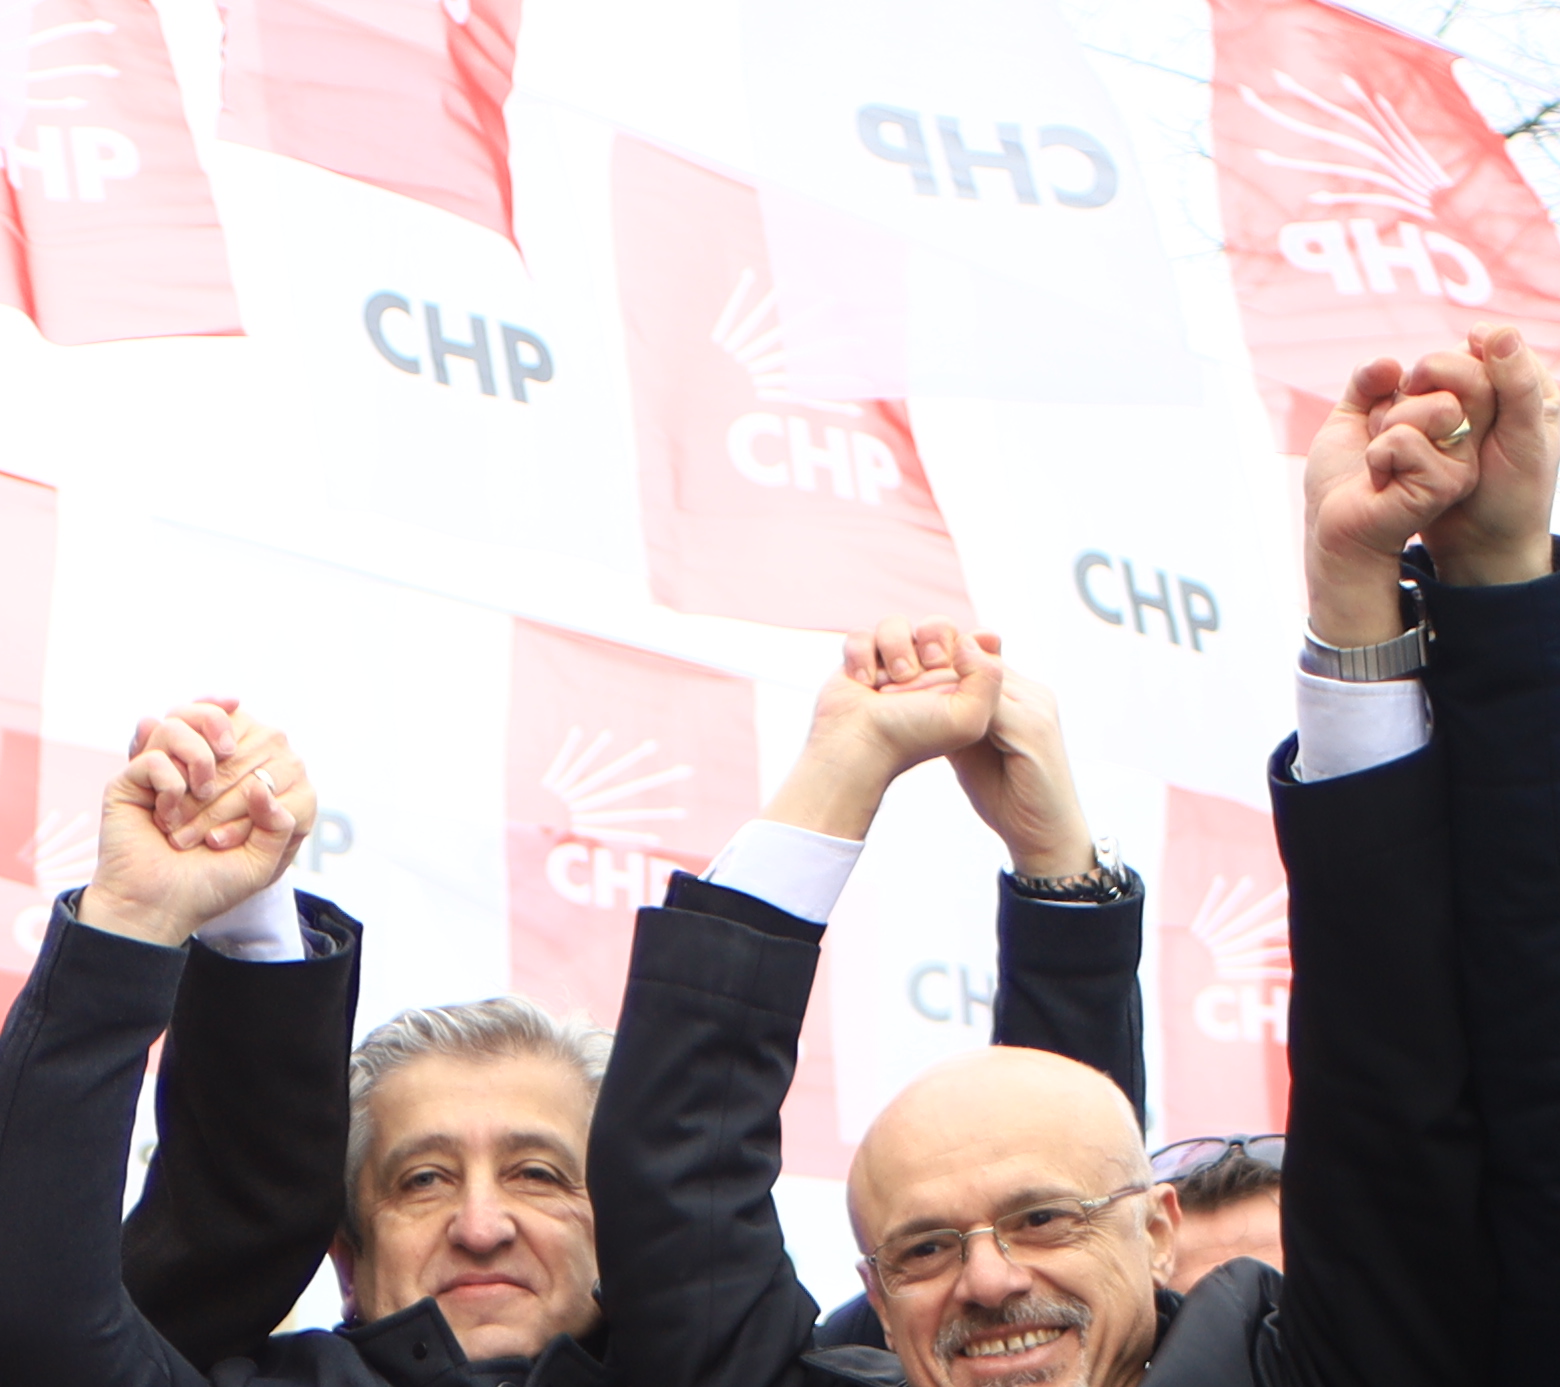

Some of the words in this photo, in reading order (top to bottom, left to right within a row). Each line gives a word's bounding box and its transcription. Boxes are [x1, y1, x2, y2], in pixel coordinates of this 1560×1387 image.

[362, 290, 555, 403] CHP
[726, 412, 902, 505] CHP
[1075, 551, 1220, 652] CHP
[908, 962, 992, 1026] CH
[1194, 986, 1288, 1043] CH
